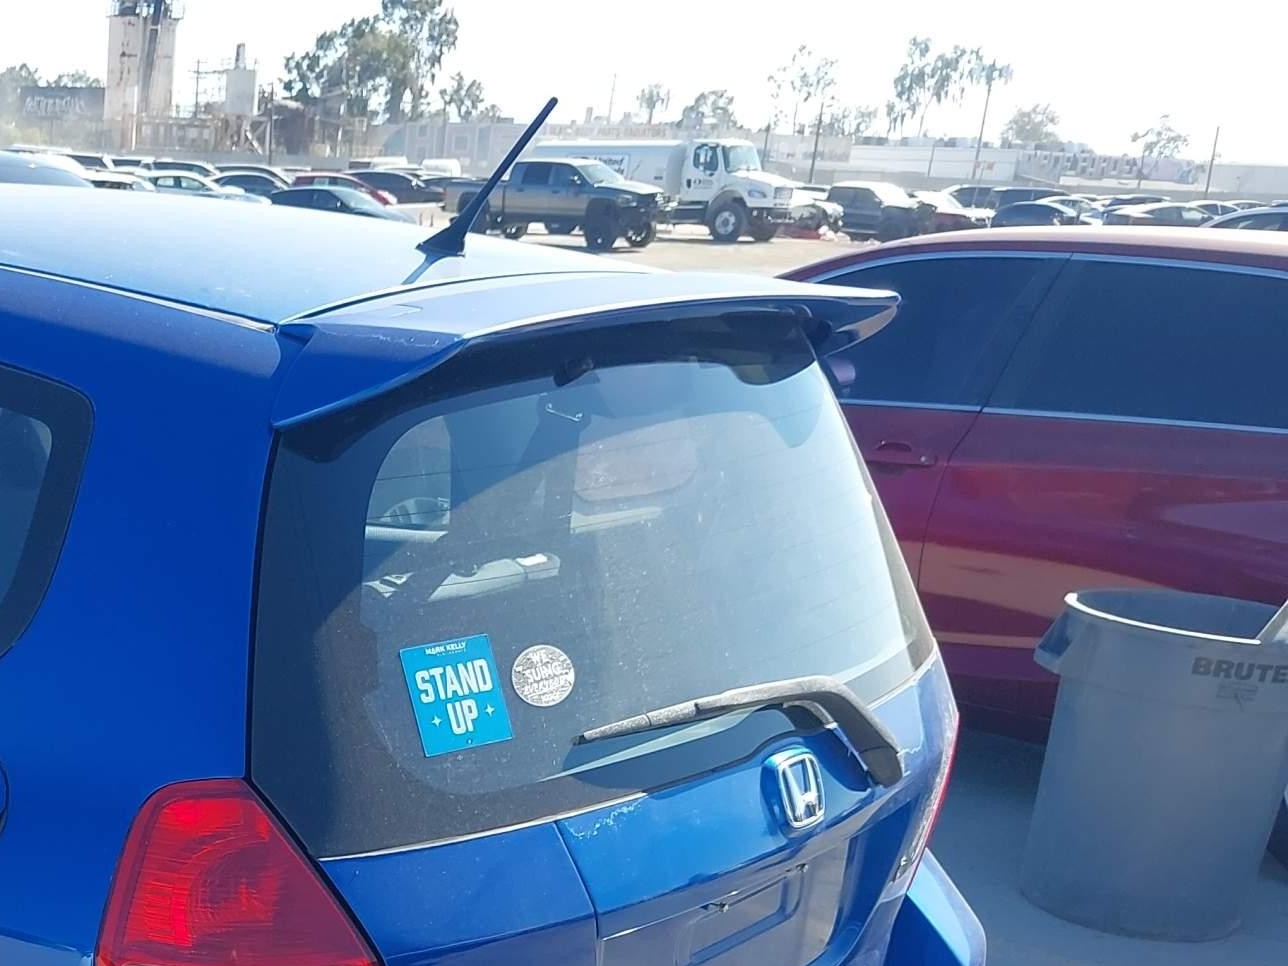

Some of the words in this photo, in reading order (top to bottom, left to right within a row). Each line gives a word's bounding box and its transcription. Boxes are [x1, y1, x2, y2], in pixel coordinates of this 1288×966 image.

[425, 645, 445, 655] MARK
[446, 641, 466, 651] KELLY
[415, 658, 493, 703] STAND
[1192, 657, 1288, 684] BRUTE
[446, 698, 479, 735] UP
